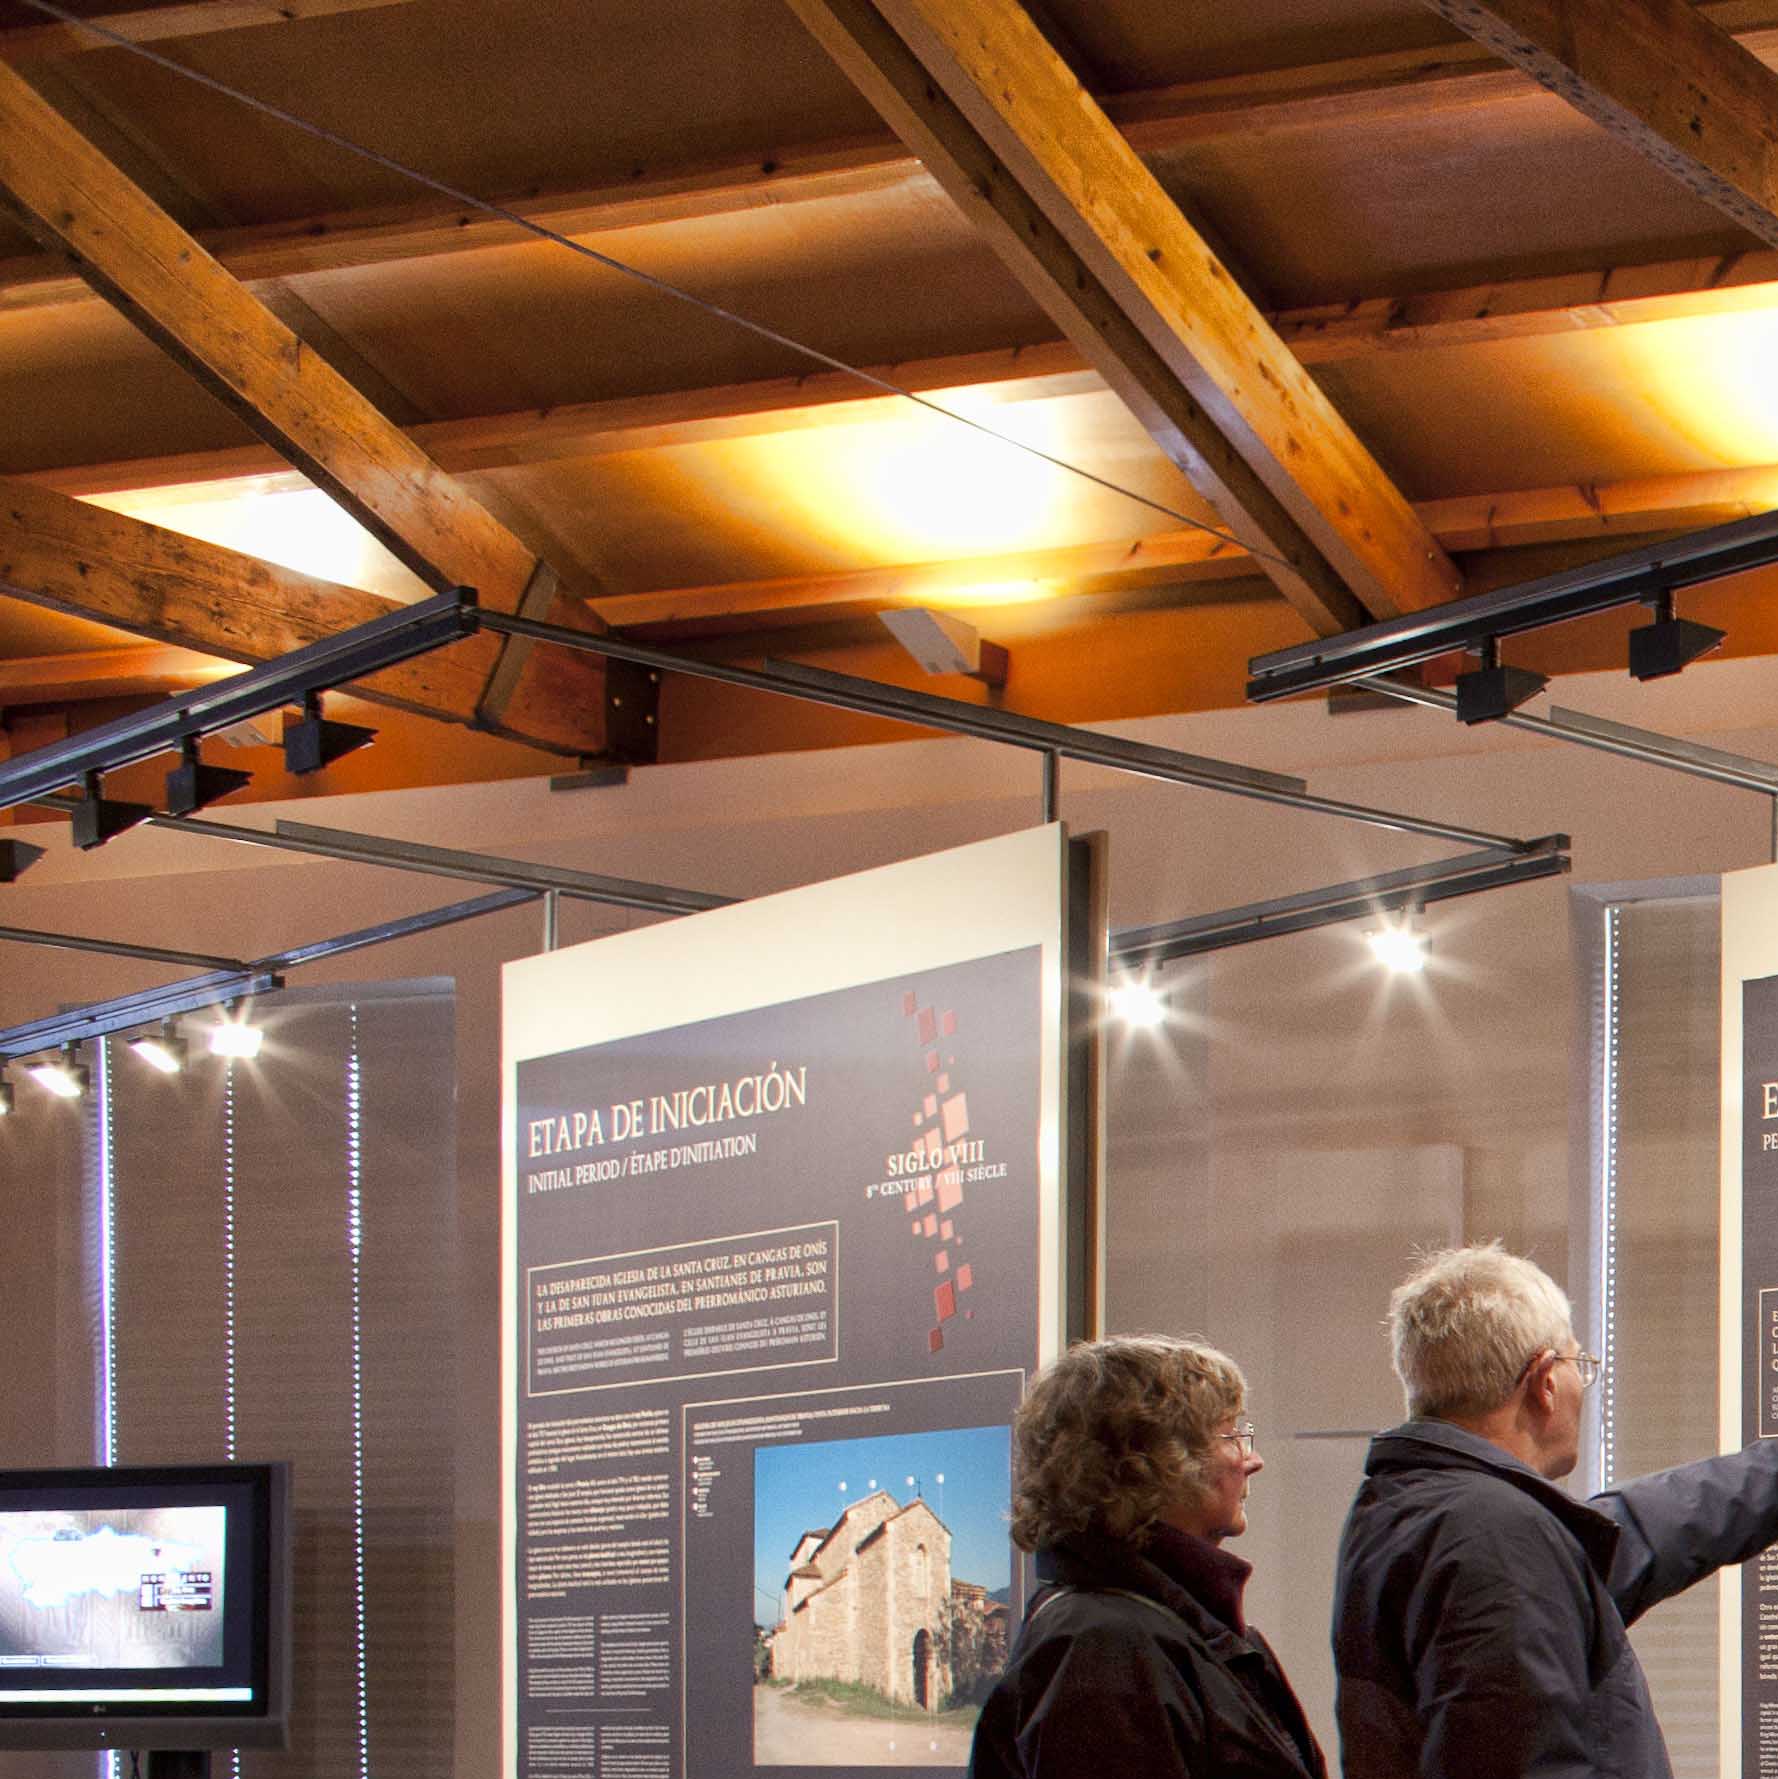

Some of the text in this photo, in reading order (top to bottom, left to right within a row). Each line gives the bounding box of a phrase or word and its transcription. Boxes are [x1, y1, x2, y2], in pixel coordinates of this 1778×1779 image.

[530, 1062, 807, 1157] ETAPA DE INICIACIÓN
[530, 1168, 573, 1193] INITIAL
[576, 1159, 620, 1184] PERIOD
[631, 1150, 667, 1174] ÉTAPE
[671, 1134, 756, 1167] D'INITIATION
[888, 1140, 985, 1177] SIGLO VIII
